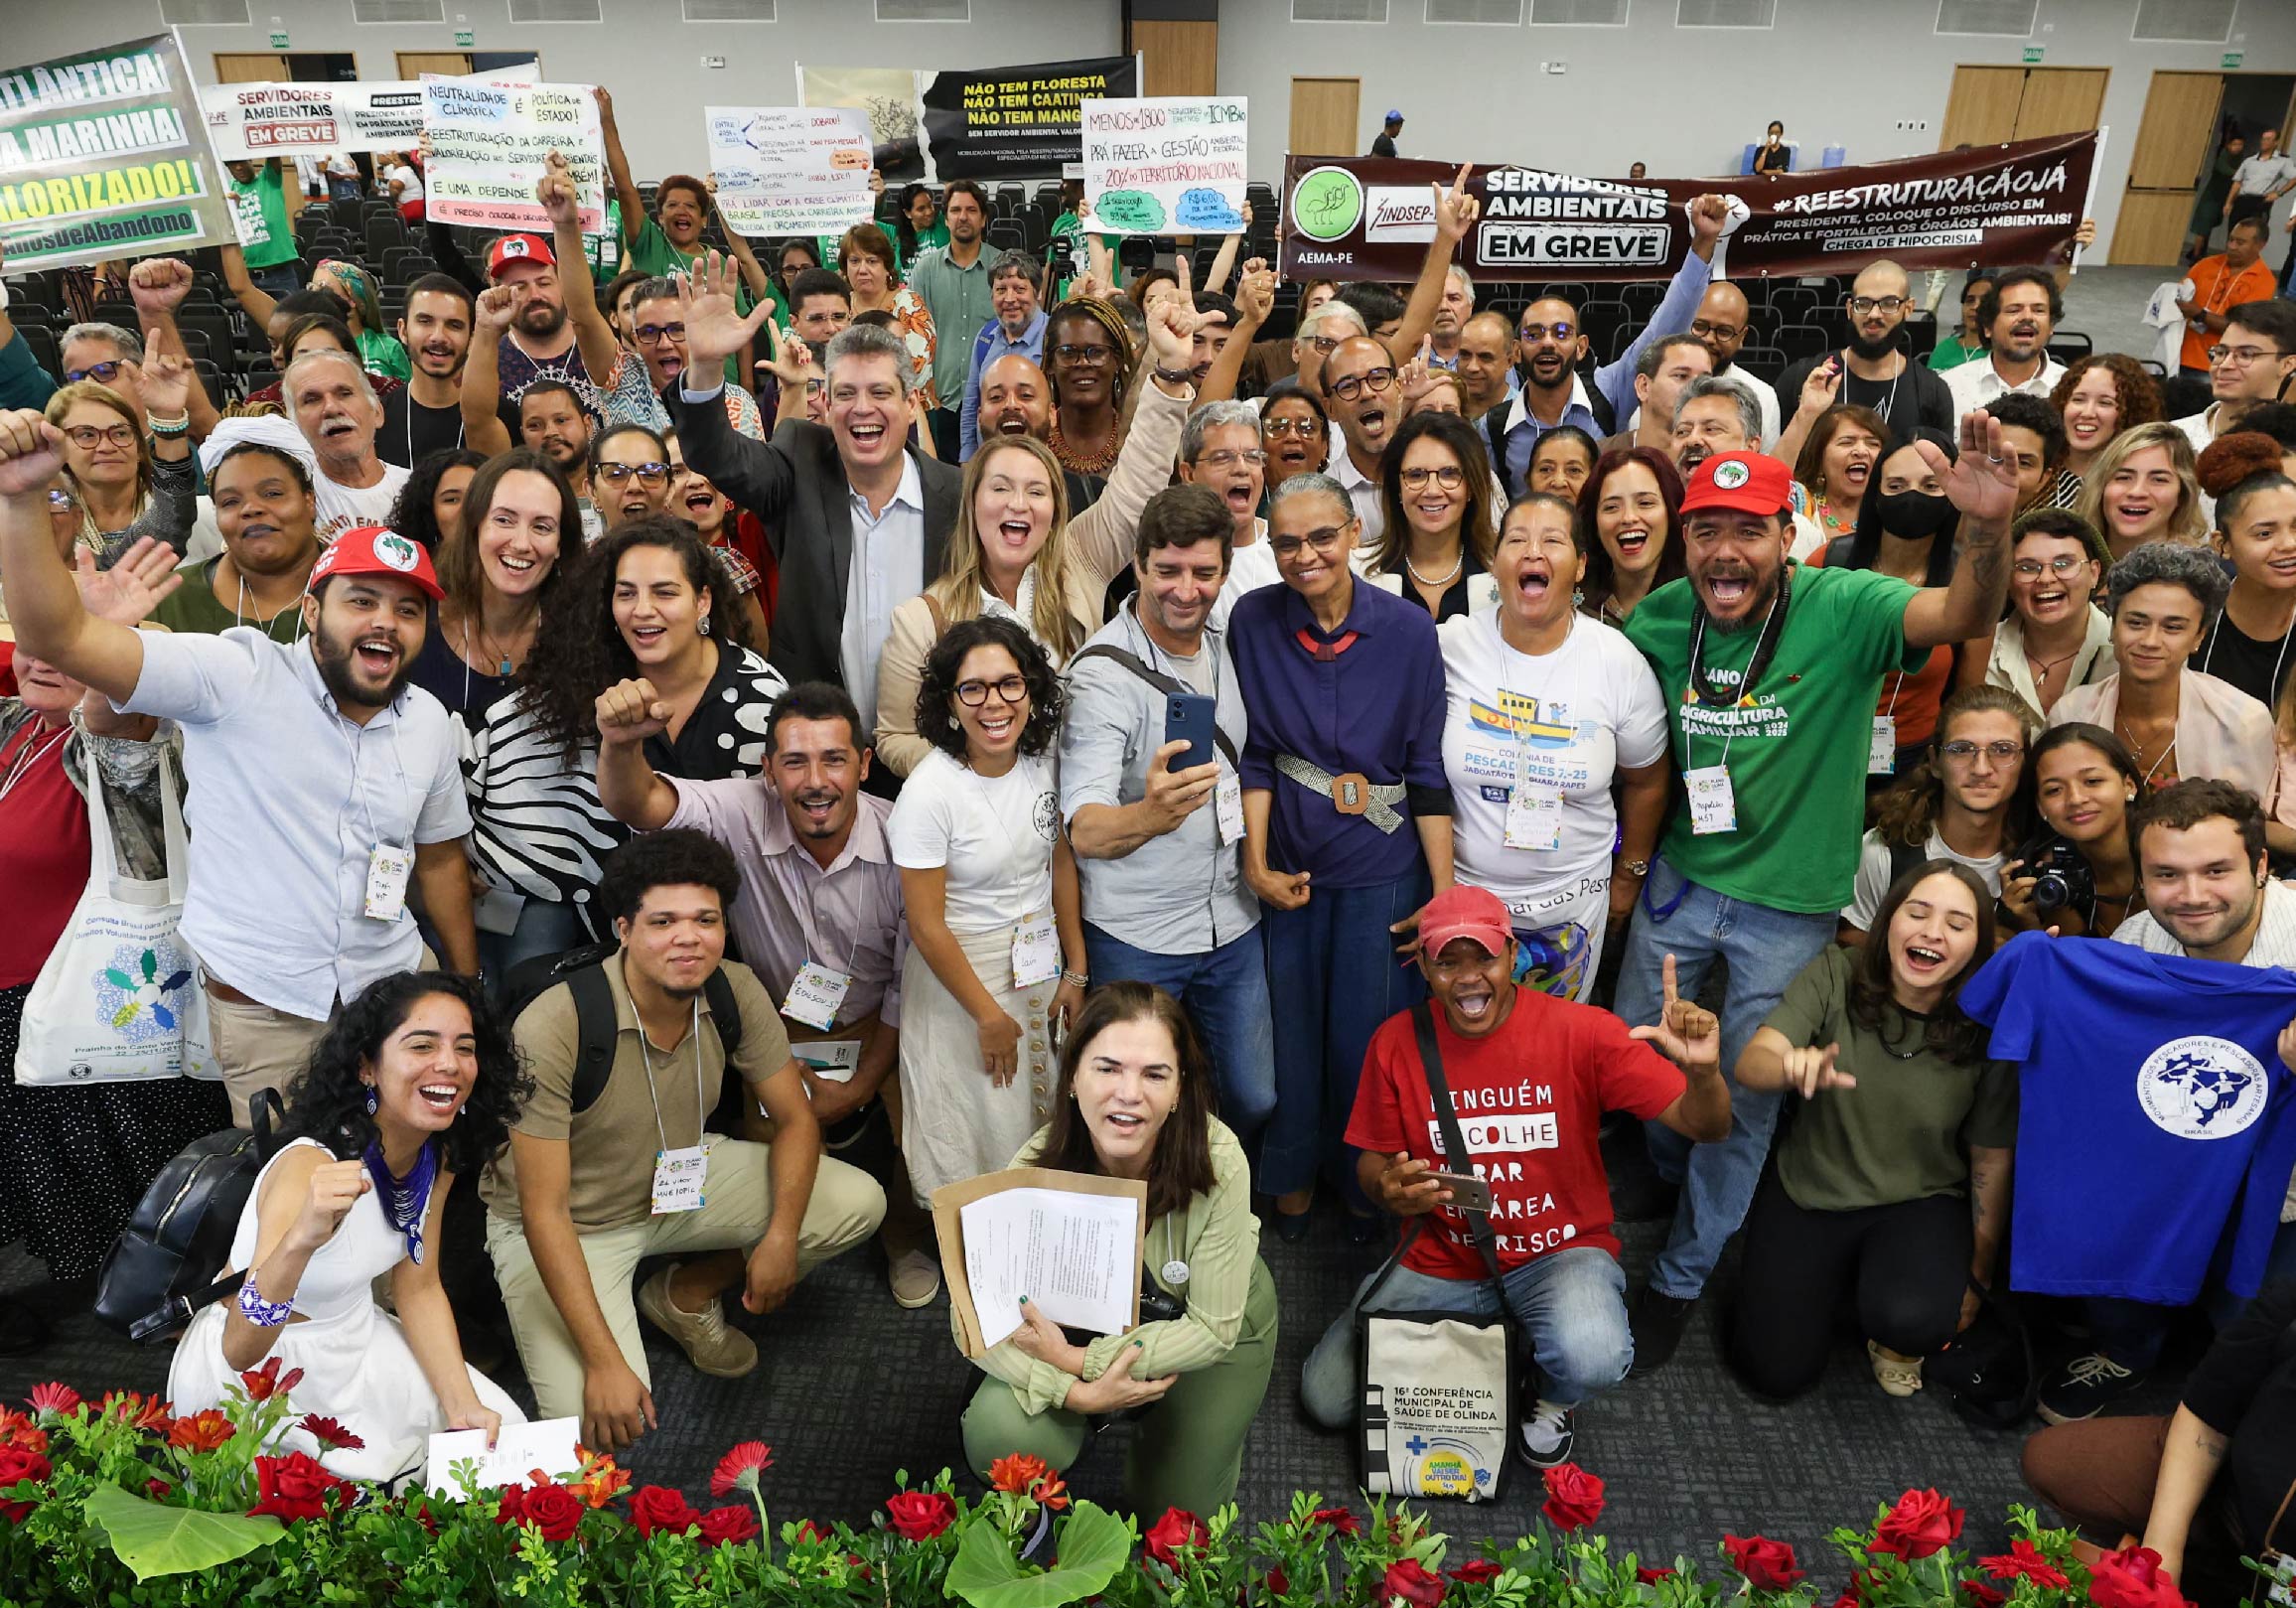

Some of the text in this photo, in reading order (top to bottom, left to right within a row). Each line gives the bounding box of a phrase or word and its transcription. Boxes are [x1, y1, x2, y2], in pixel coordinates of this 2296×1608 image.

[964, 74, 1106, 95] NÃO TEM FLORESTA
[237, 89, 332, 105] SERVIDORES
[963, 95, 994, 108] NÃO
[998, 95, 1027, 106] TEM
[244, 104, 333, 120] AMBIENTAIS
[967, 108, 1081, 125] NÃO TEM MANG
[1089, 108, 1166, 131] MENOS 1800
[24, 107, 182, 161] MARINHA
[248, 126, 332, 144] EM GREVE
[507, 152, 546, 164] SERVIDORE
[1112, 142, 1149, 161] FAZER
[1161, 135, 1209, 158] GESTÃO
[1105, 167, 1129, 189] 20%
[1140, 160, 1197, 183] TERRITÓRIO
[1197, 160, 1247, 181] NACIONAL
[1486, 169, 1668, 200] SERVIDORES
[448, 183, 529, 200] UMA DEPENDE
[1773, 159, 2069, 215] #REESTRUTURAÇÃOJÁ
[744, 198, 771, 208] LIDAR
[777, 198, 791, 207] COM
[1486, 197, 1668, 219] AMBIENTAIS
[1775, 197, 2045, 229] PRESIDENTE, COLOQUE O DISCURSO EM
[1369, 198, 1436, 230] SINDSEP-
[1743, 212, 2072, 244] PRÁTICA E FORTALEÇA OS ÓRGÃOS AMBIENTAIS!
[1493, 234, 1658, 258] EM GREVE
[1825, 232, 1982, 250] CHEGA DE HIPOCRISIA.
[1297, 251, 1353, 265] AEMA-PE
[1759, 693, 1776, 705] DA
[1679, 704, 1789, 725] AGRICULTURA
[1465, 752, 1555, 778] PESCADRES
[1499, 749, 1555, 764] COLNIA DE
[1463, 765, 1507, 780] JABOATÃO
[85, 917, 119, 926] Consulta
[2153, 1040, 2210, 1067] PESCADORES
[2219, 1044, 2262, 1084] PESCADORAS
[2144, 1065, 2158, 1081] DOS
[2142, 1081, 2166, 1122] MOVIMENTO
[2235, 1084, 2263, 1125] ARTESANAIS
[1434, 1122, 1554, 1148] ECOLHE
[1439, 1161, 1524, 1184] MRAR
[1490, 1192, 1556, 1220] ÁREA
[1394, 1396, 1474, 1409] MUNICIPAL DE
[1413, 1387, 1494, 1399] CONFERÊNCIA
[1394, 1405, 1498, 1420] SAÚDE DE OLINDA
